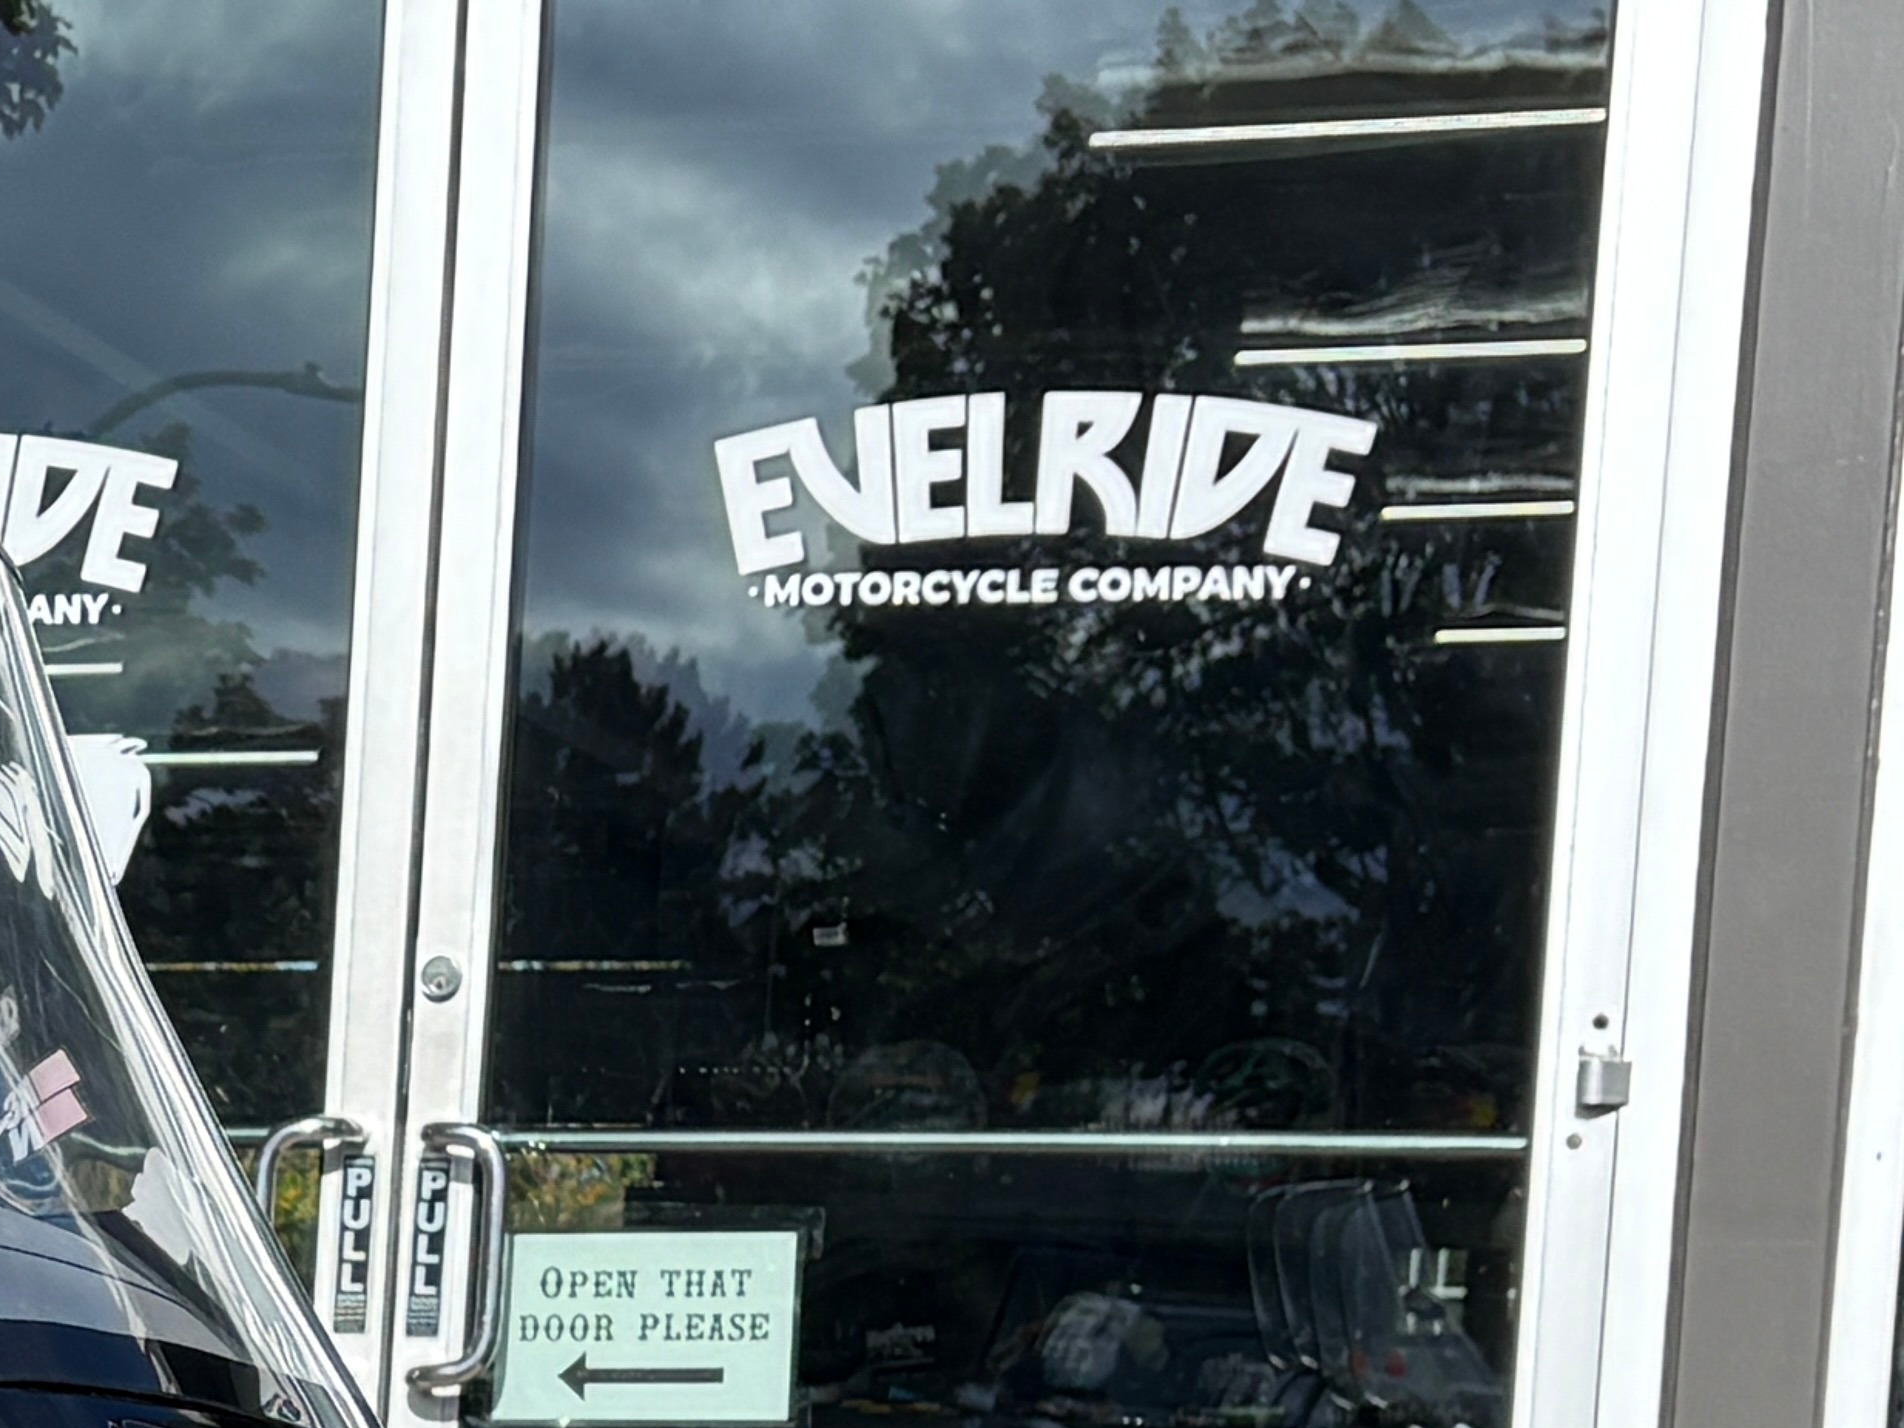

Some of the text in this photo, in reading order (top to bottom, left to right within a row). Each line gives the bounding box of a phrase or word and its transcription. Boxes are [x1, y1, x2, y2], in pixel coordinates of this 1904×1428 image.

[763, 566, 1292, 608] MOTORCYCLE COMPANY
[341, 1167, 372, 1292] PULL
[414, 1170, 447, 1295] PULL
[540, 1266, 753, 1299] OPEN THAT
[519, 1312, 770, 1342] DOOR PLEASE
